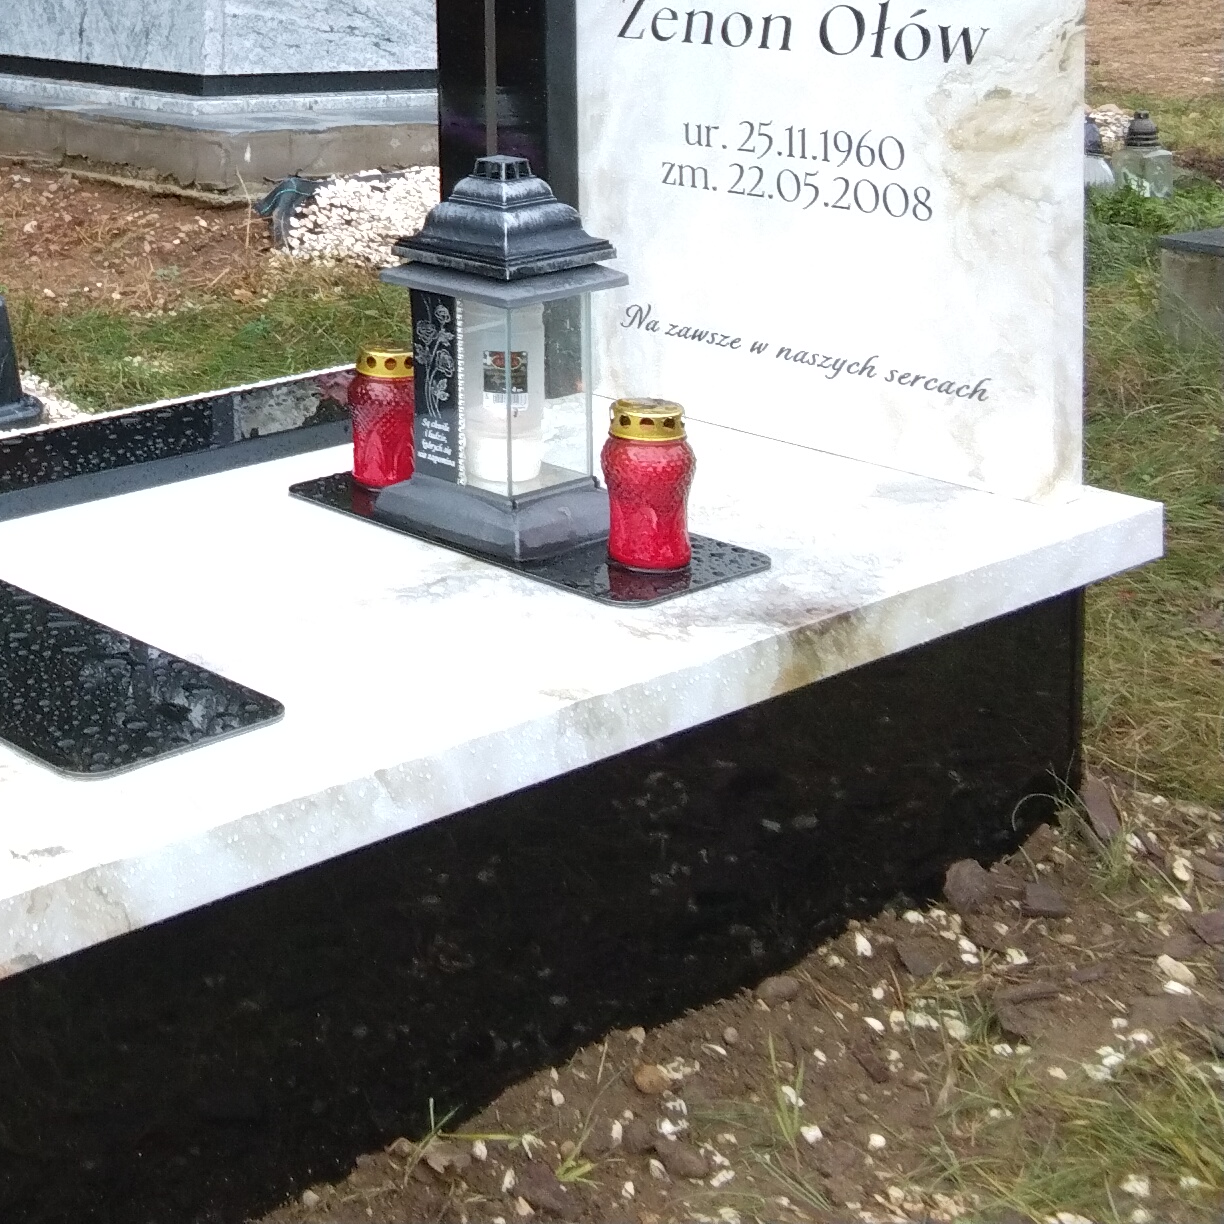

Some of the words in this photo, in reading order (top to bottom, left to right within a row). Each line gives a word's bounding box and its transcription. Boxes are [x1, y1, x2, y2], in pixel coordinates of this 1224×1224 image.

[819, 0, 991, 65] Ołów
[683, 121, 727, 150] ur.
[737, 120, 905, 171] 25.11.1960
[662, 161, 718, 191] zm.
[727, 163, 933, 221] 22.05.2008
[620, 303, 660, 333] Na
[664, 322, 742, 350] zawsze
[749, 340, 769, 355] w
[775, 344, 880, 380] naszych
[884, 366, 992, 402] sercach
